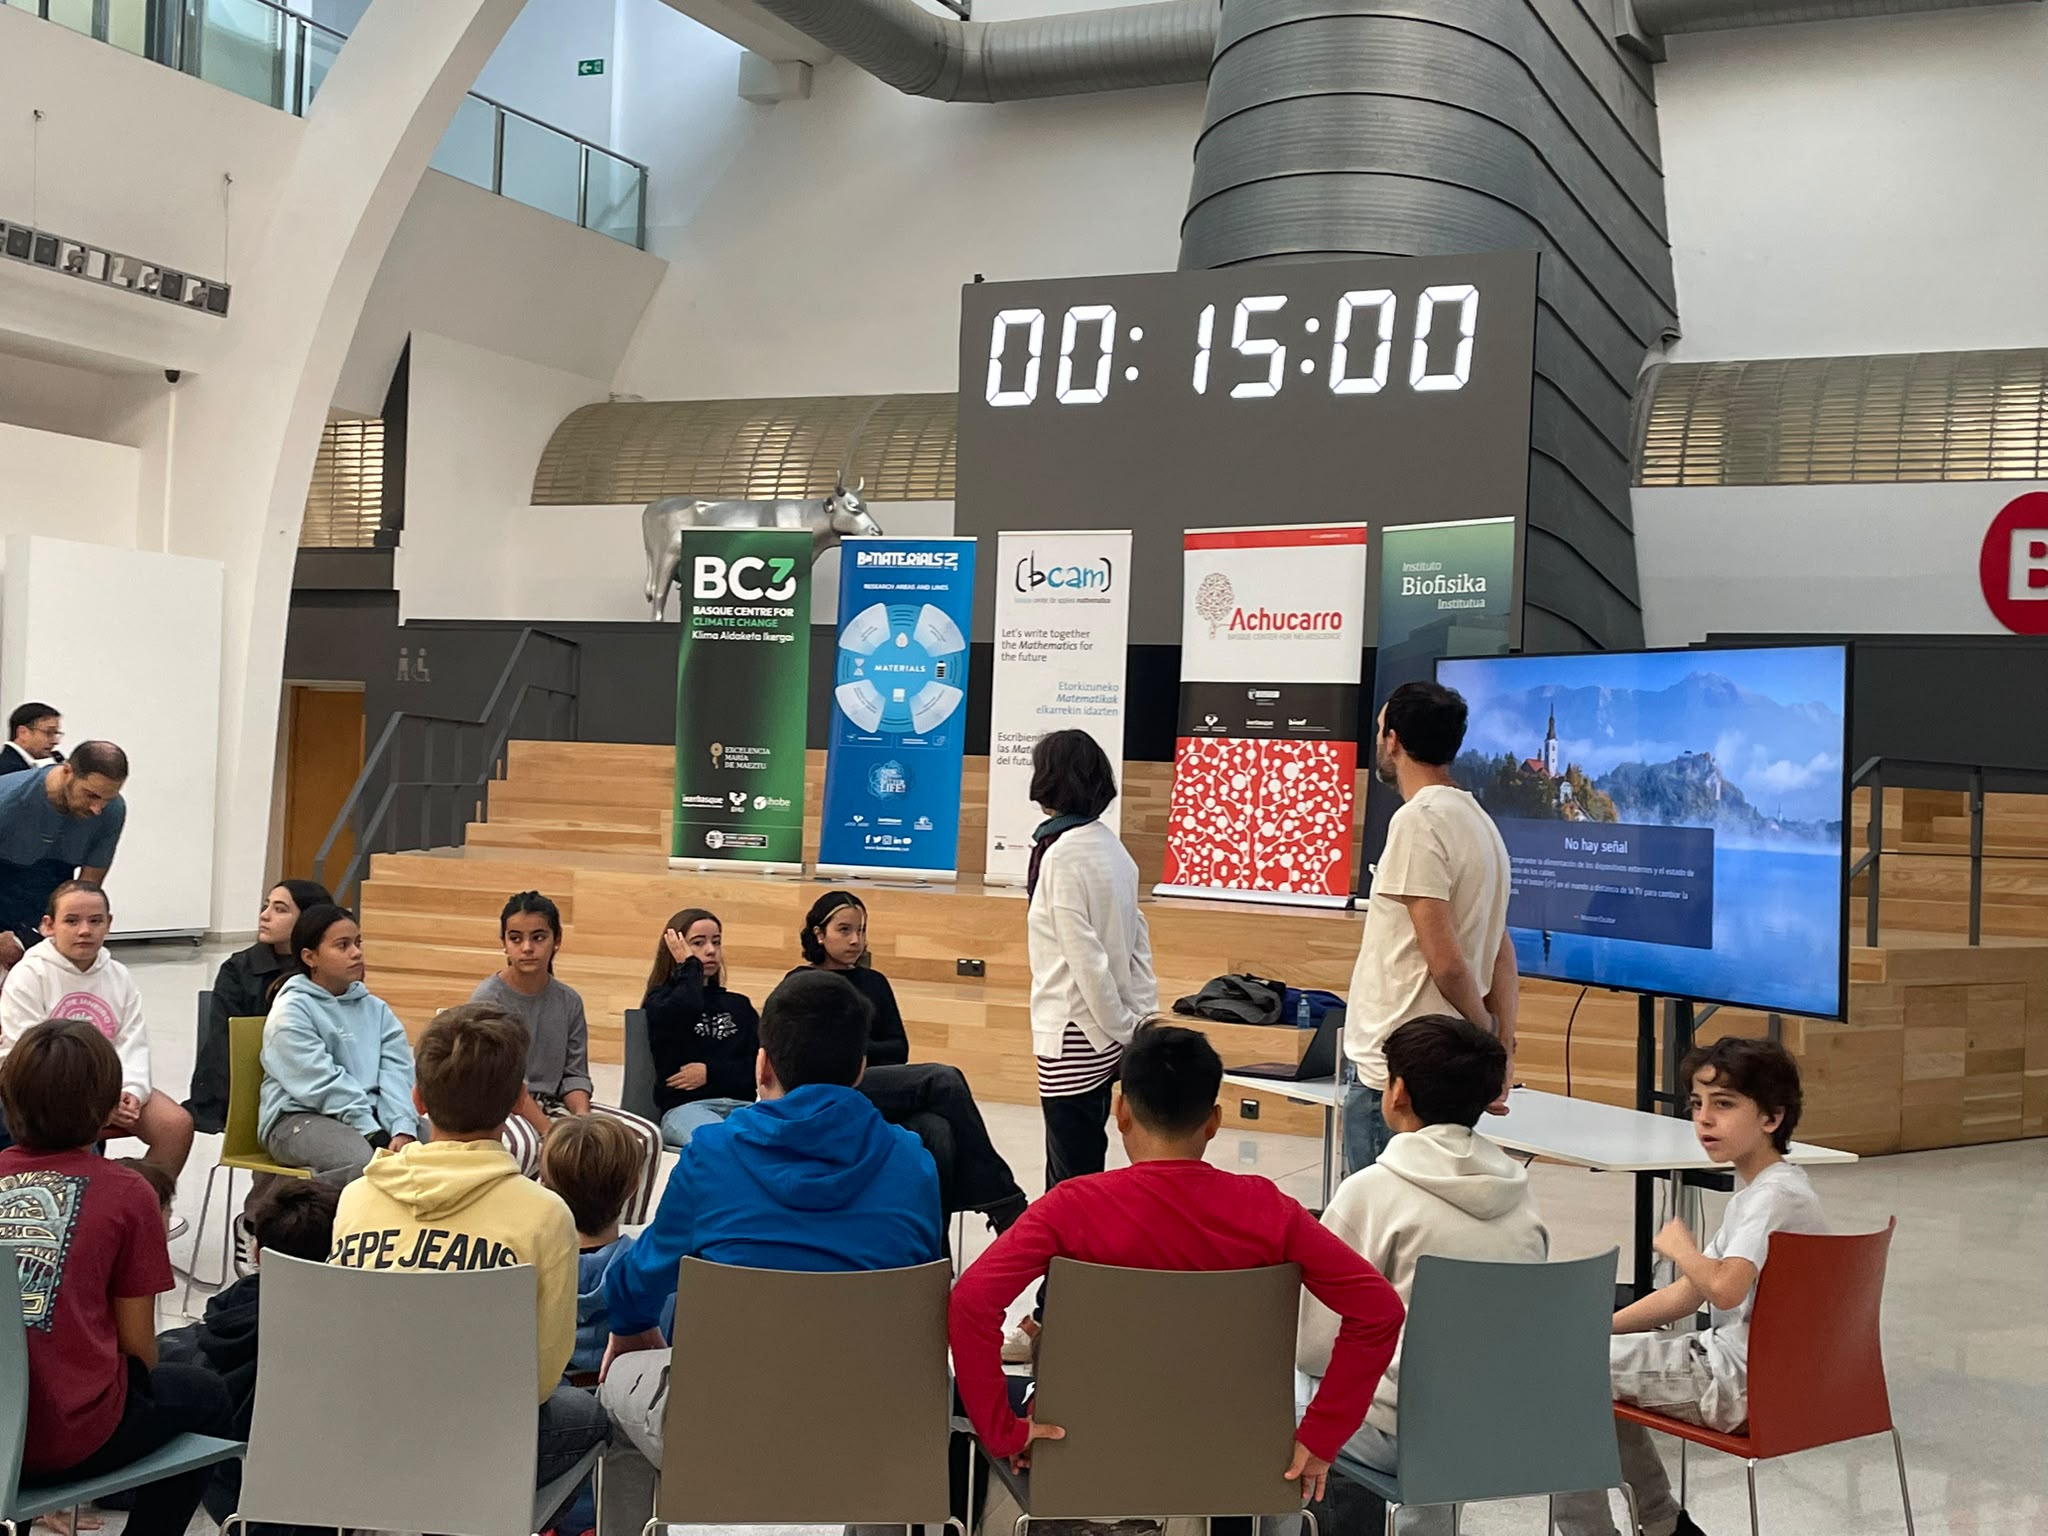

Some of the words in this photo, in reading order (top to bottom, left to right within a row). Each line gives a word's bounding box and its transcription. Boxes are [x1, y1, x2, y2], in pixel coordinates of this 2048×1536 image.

[1402, 561, 1442, 572] Instituto
[693, 556, 797, 602] BC3
[1401, 573, 1487, 596] Biofisika
[1437, 599, 1486, 610] Institutua
[692, 605, 734, 616] BASQUE
[734, 606, 773, 617] CENTRE
[773, 607, 795, 617] FOR
[692, 617, 735, 627] CLIMATE
[736, 618, 778, 628] CHANGE
[1229, 607, 1343, 631] Achucarro
[692, 630, 719, 640] Klima
[1001, 629, 1023, 639] Let's
[1024, 629, 1048, 639] write
[1050, 629, 1091, 641] together
[1001, 640, 1017, 650] the
[1018, 641, 1078, 651] Mathematics
[1079, 641, 1094, 651] for
[1001, 652, 1017, 662] the
[1018, 652, 1048, 662] future
[874, 665, 926, 673] MATERIALS
[1058, 681, 1119, 692] Etorkizuneko
[1056, 694, 1119, 704] Matematikak
[1036, 705, 1082, 715] elkarrekin
[1084, 706, 1119, 716] idazten
[997, 744, 1010, 753] las
[724, 761, 735, 769] DE
[996, 756, 1010, 765] del
[1565, 837, 1579, 850] No
[1581, 838, 1599, 855] hay
[1600, 840, 1628, 854] señal
[325, 1228, 401, 1269] PEPE
